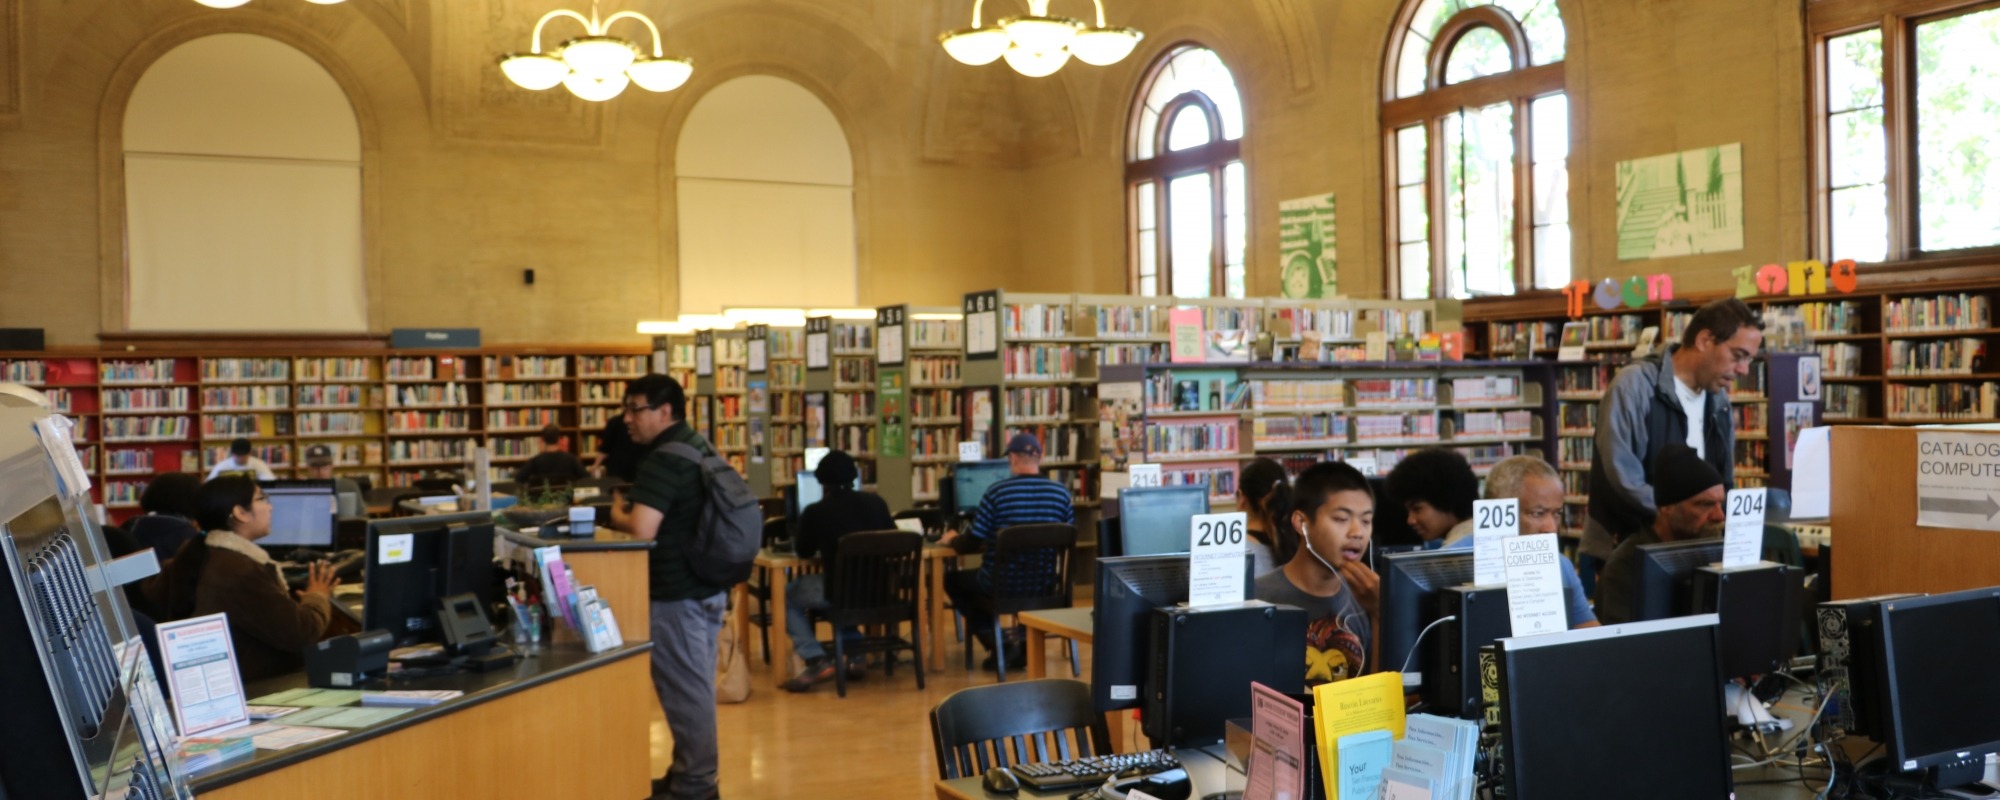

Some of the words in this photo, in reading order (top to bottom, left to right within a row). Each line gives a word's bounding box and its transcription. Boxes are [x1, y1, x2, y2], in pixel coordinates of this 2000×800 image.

[977, 296, 984, 312] 6
[961, 443, 979, 454] 213
[1920, 441, 2000, 457] CATALOG
[1132, 473, 1159, 488] 214
[1732, 493, 1763, 516] 204
[1479, 504, 1516, 529] 205
[1197, 520, 1242, 546] 206
[1509, 540, 1549, 552] CATALOG
[1507, 552, 1554, 566] COMPUTER
[1349, 762, 1367, 775] Your
